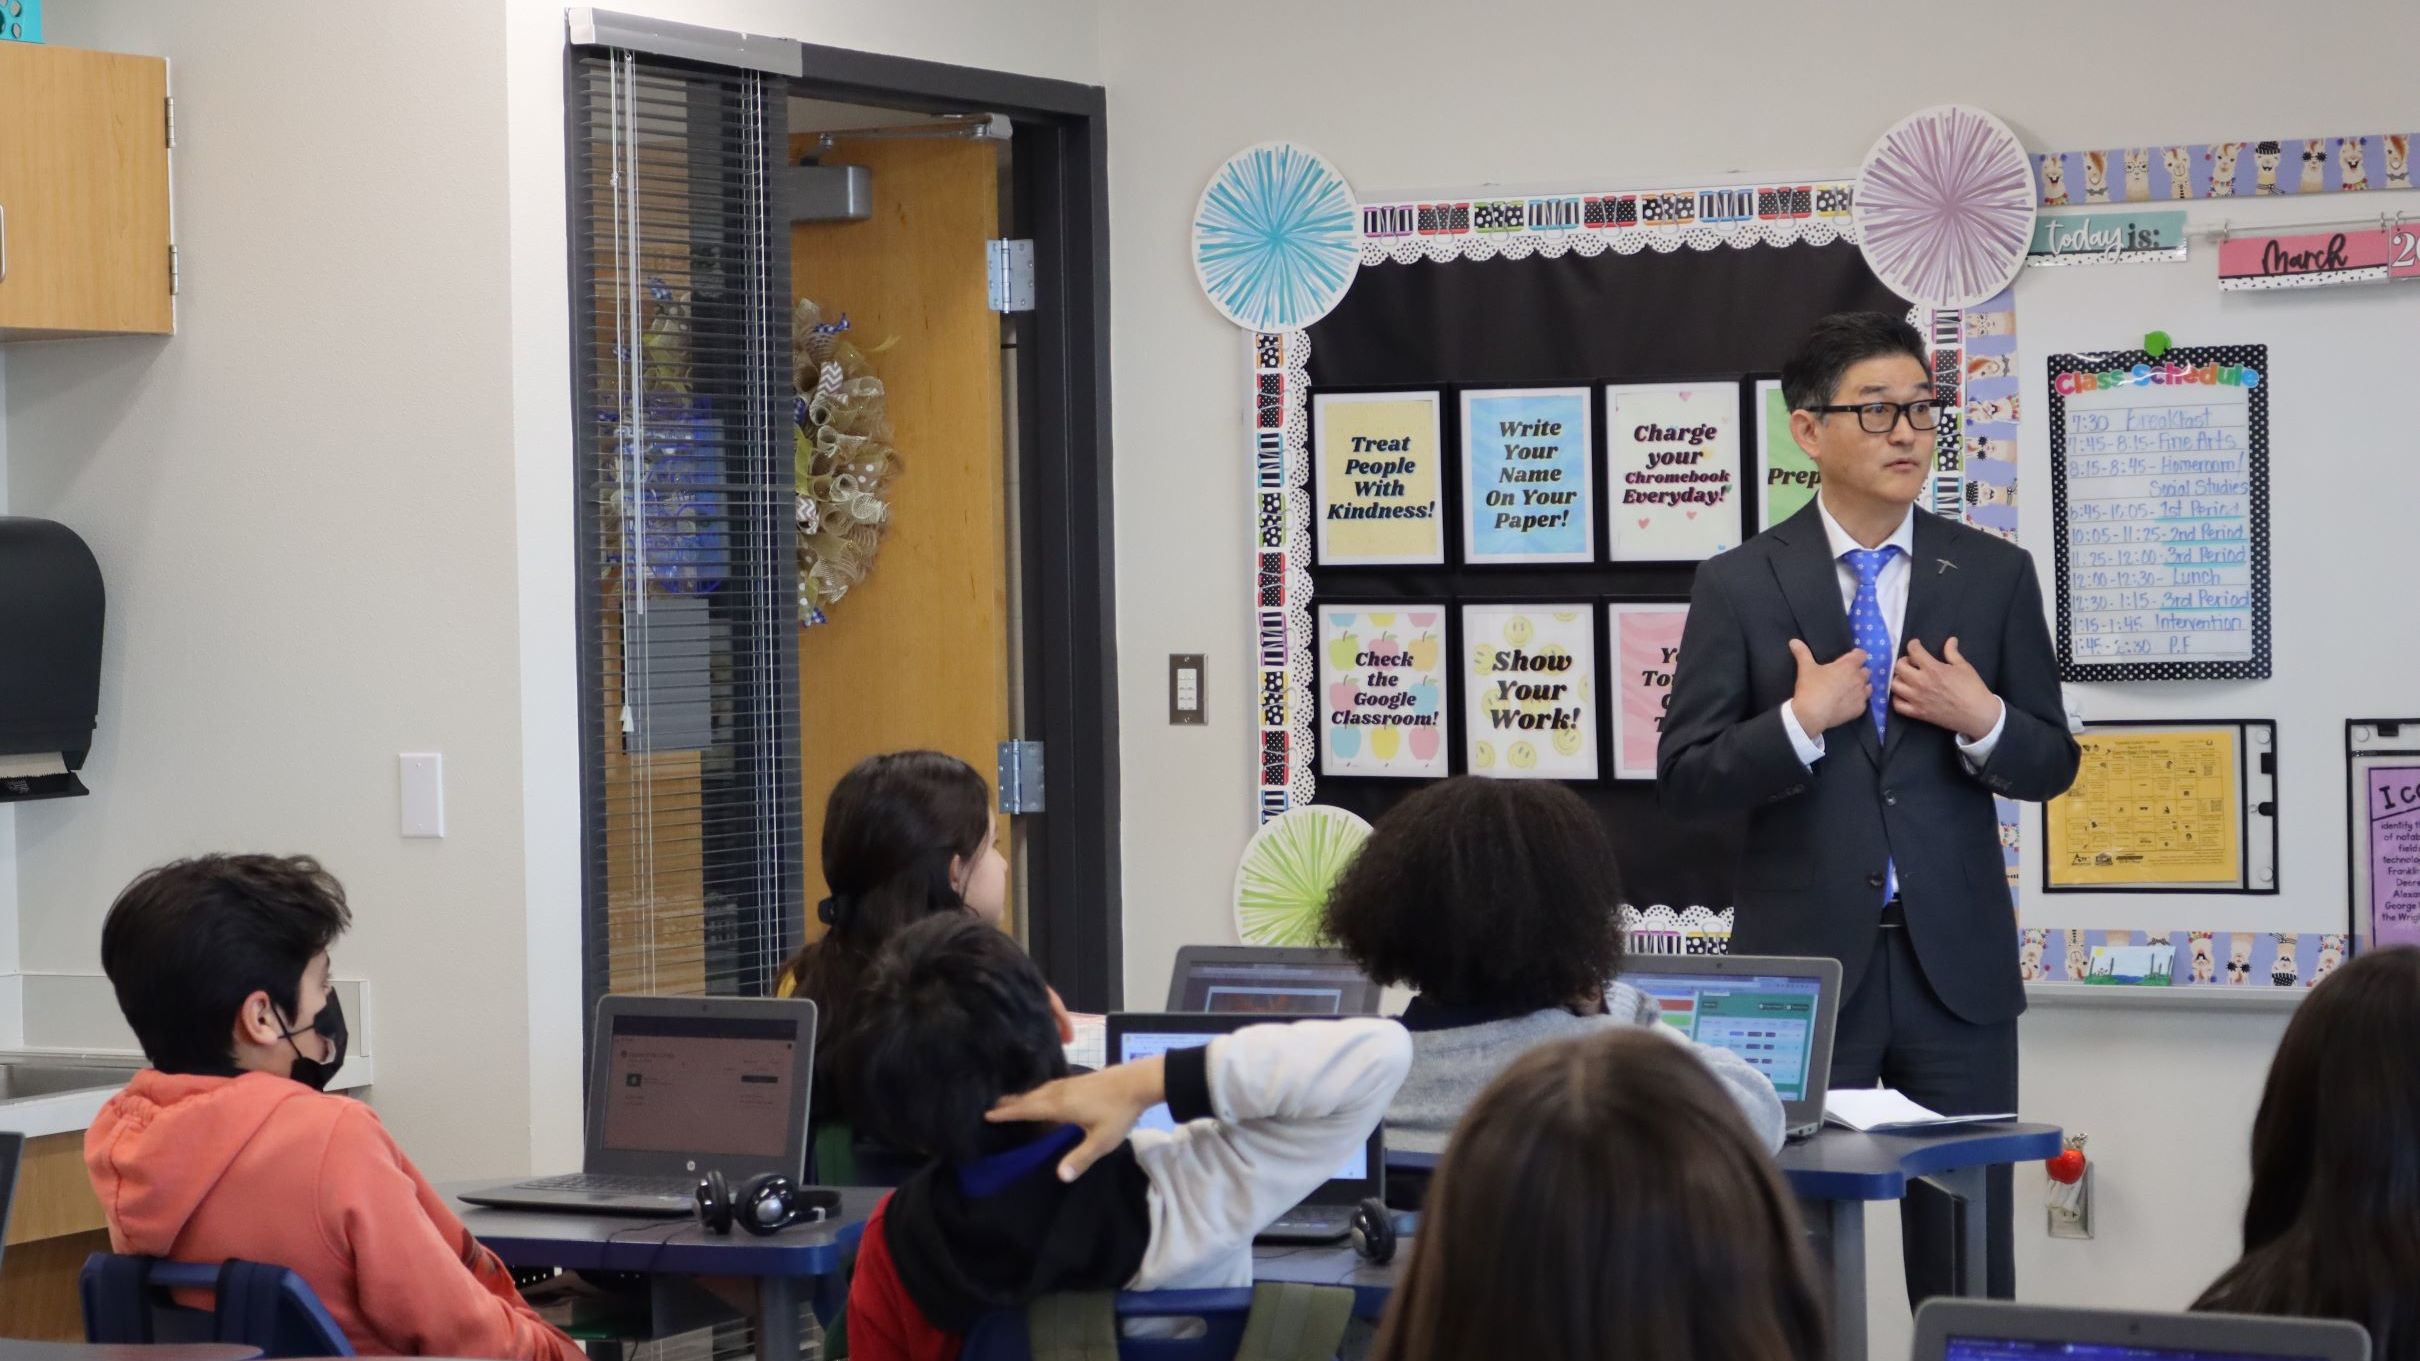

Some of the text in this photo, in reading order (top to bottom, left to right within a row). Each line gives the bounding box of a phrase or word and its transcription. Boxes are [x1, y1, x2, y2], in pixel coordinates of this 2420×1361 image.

[2045, 217, 2160, 262] today is:
[2262, 232, 2349, 275] March
[2054, 361, 2260, 395] Class Schedule
[1498, 419, 1562, 437] Write
[2071, 414, 2110, 432] 7:30
[1633, 424, 1717, 445] Charge
[2159, 432, 2194, 449] Fine
[2198, 430, 2236, 449] Arts
[1350, 436, 1411, 453] Treat
[1503, 445, 1559, 460] Your
[1344, 457, 1416, 478] People
[1646, 451, 1703, 469] your
[1498, 468, 1562, 483] Name
[1624, 470, 1730, 483] Chromebook
[1354, 480, 1405, 496] With
[1622, 486, 1727, 506] Everyday!
[2149, 477, 2249, 498] Social Studies
[1485, 489, 1577, 506] On Your
[1327, 501, 1435, 519] Kindness!
[2160, 499, 2181, 517] 1st
[1494, 510, 1569, 532] Paper!
[2170, 525, 2196, 540] 2nd
[2201, 522, 2244, 540] Period
[2167, 545, 2192, 563] 3rd
[2200, 546, 2246, 563] Period
[2173, 567, 2221, 585] Lunch
[2163, 591, 2193, 608] 3rd
[2198, 588, 2250, 607] Period
[2154, 612, 2242, 631] Intervention
[1355, 652, 1414, 667] Check
[1491, 650, 1573, 672] Show
[1661, 648, 1680, 663] Y
[1367, 671, 1399, 687] the
[1353, 692, 1417, 707] Google
[1496, 681, 1568, 700] Your
[1331, 710, 1439, 726] Classroom!
[1489, 708, 1581, 730] Work!
[2379, 785, 2396, 809] I
[2381, 822, 2412, 831] identify
[2384, 833, 2393, 841] of
[2385, 902, 2416, 913] George
[2382, 913, 2396, 921] the
